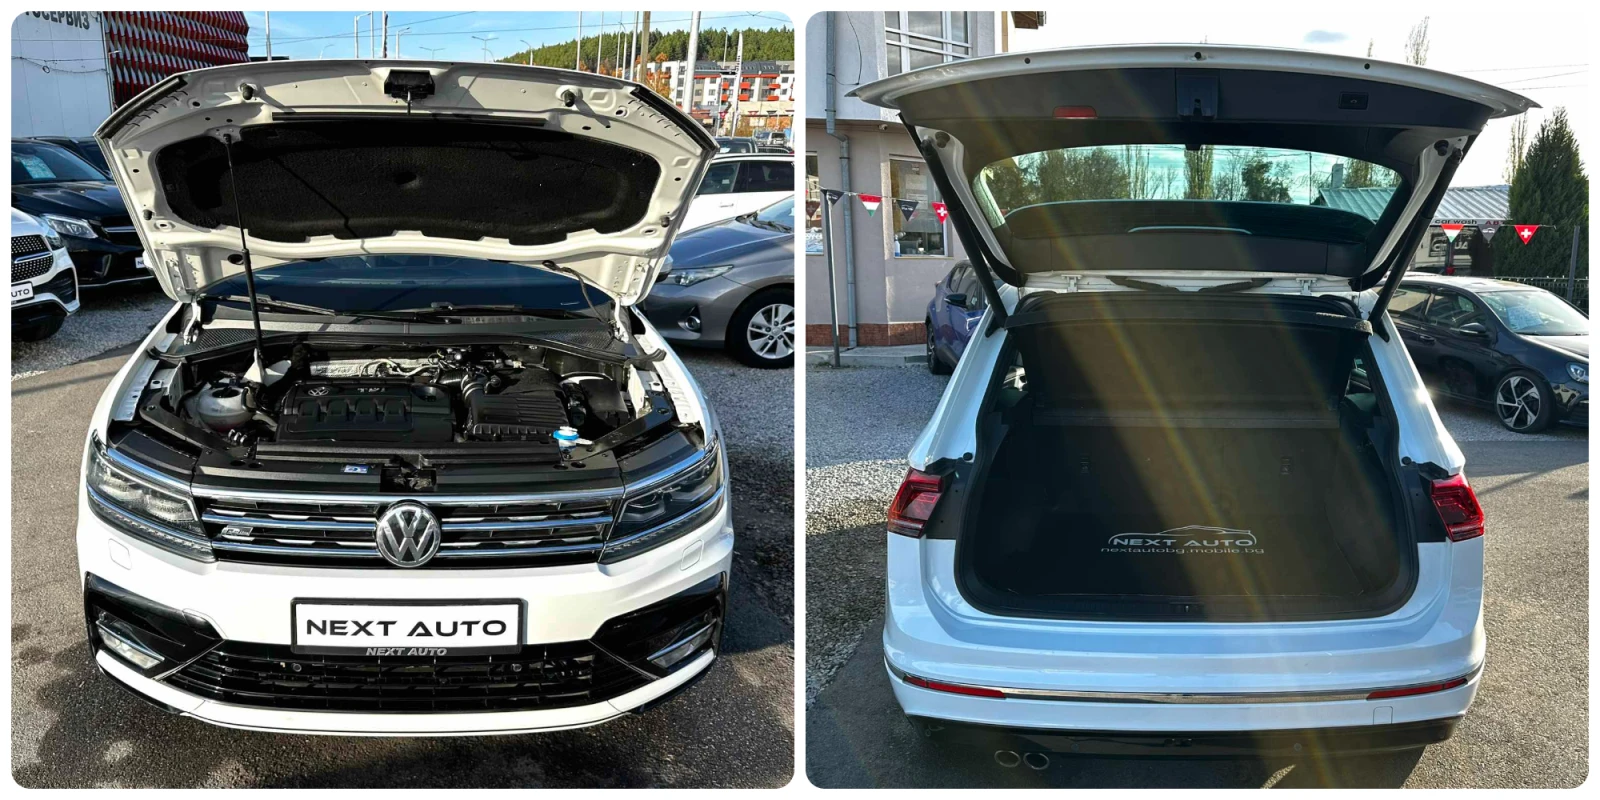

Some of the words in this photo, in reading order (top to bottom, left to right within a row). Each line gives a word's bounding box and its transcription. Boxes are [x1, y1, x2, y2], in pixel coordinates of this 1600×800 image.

[1112, 538, 1176, 546] NEXT
[1183, 539, 1253, 547] AUTO
[1100, 546, 1265, 555] nextautobg.mobile.bg
[306, 619, 398, 637] NEXT
[406, 619, 507, 637] AUTO
[366, 647, 407, 656] NEXT
[408, 647, 447, 656] AUTO
